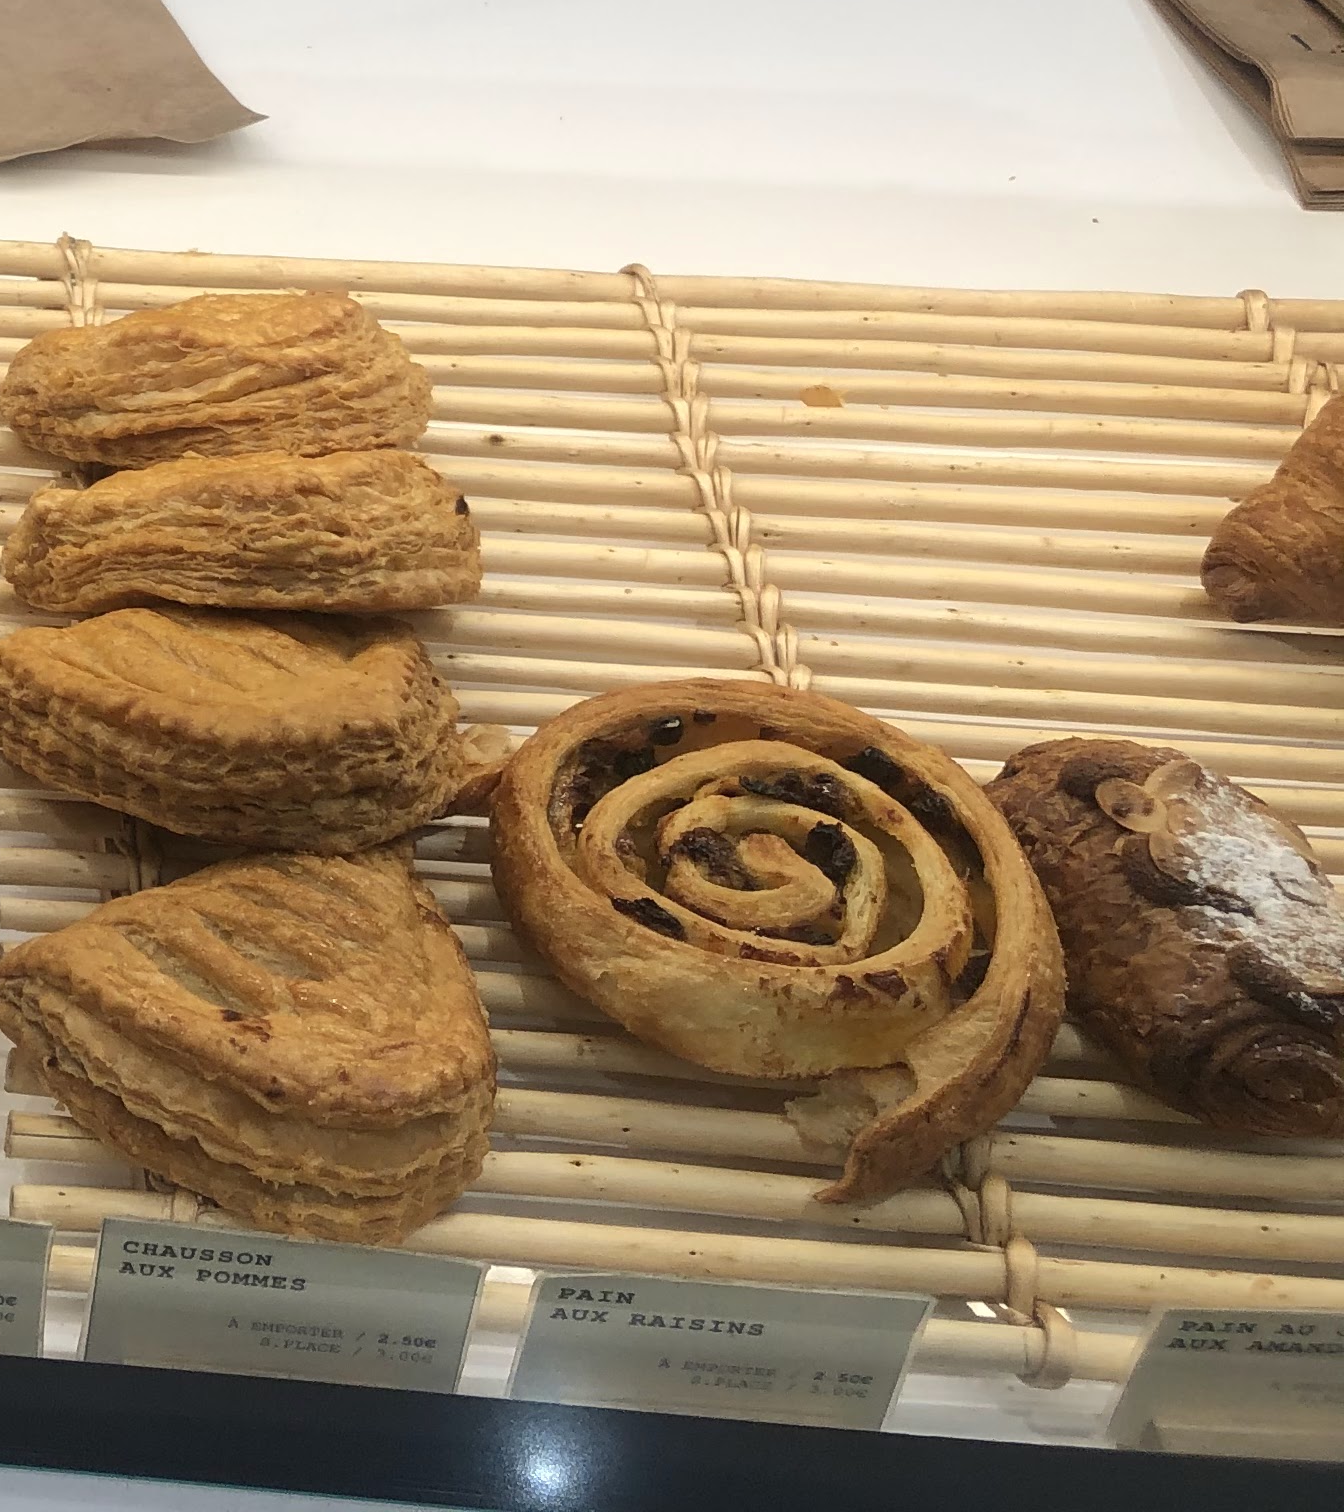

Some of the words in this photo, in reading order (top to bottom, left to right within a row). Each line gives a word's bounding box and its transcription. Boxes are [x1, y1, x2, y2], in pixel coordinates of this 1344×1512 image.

[123, 1240, 272, 1267] CHAUSSON
[119, 1261, 176, 1278] AUX
[196, 1269, 307, 1291] POMMES
[557, 1288, 635, 1305] PAIN
[550, 1307, 608, 1323] AUX
[628, 1313, 765, 1337] RAISINS
[1179, 1320, 1258, 1334] PAIN
[1274, 1324, 1316, 1336] AU
[1166, 1338, 1228, 1352] AUX
